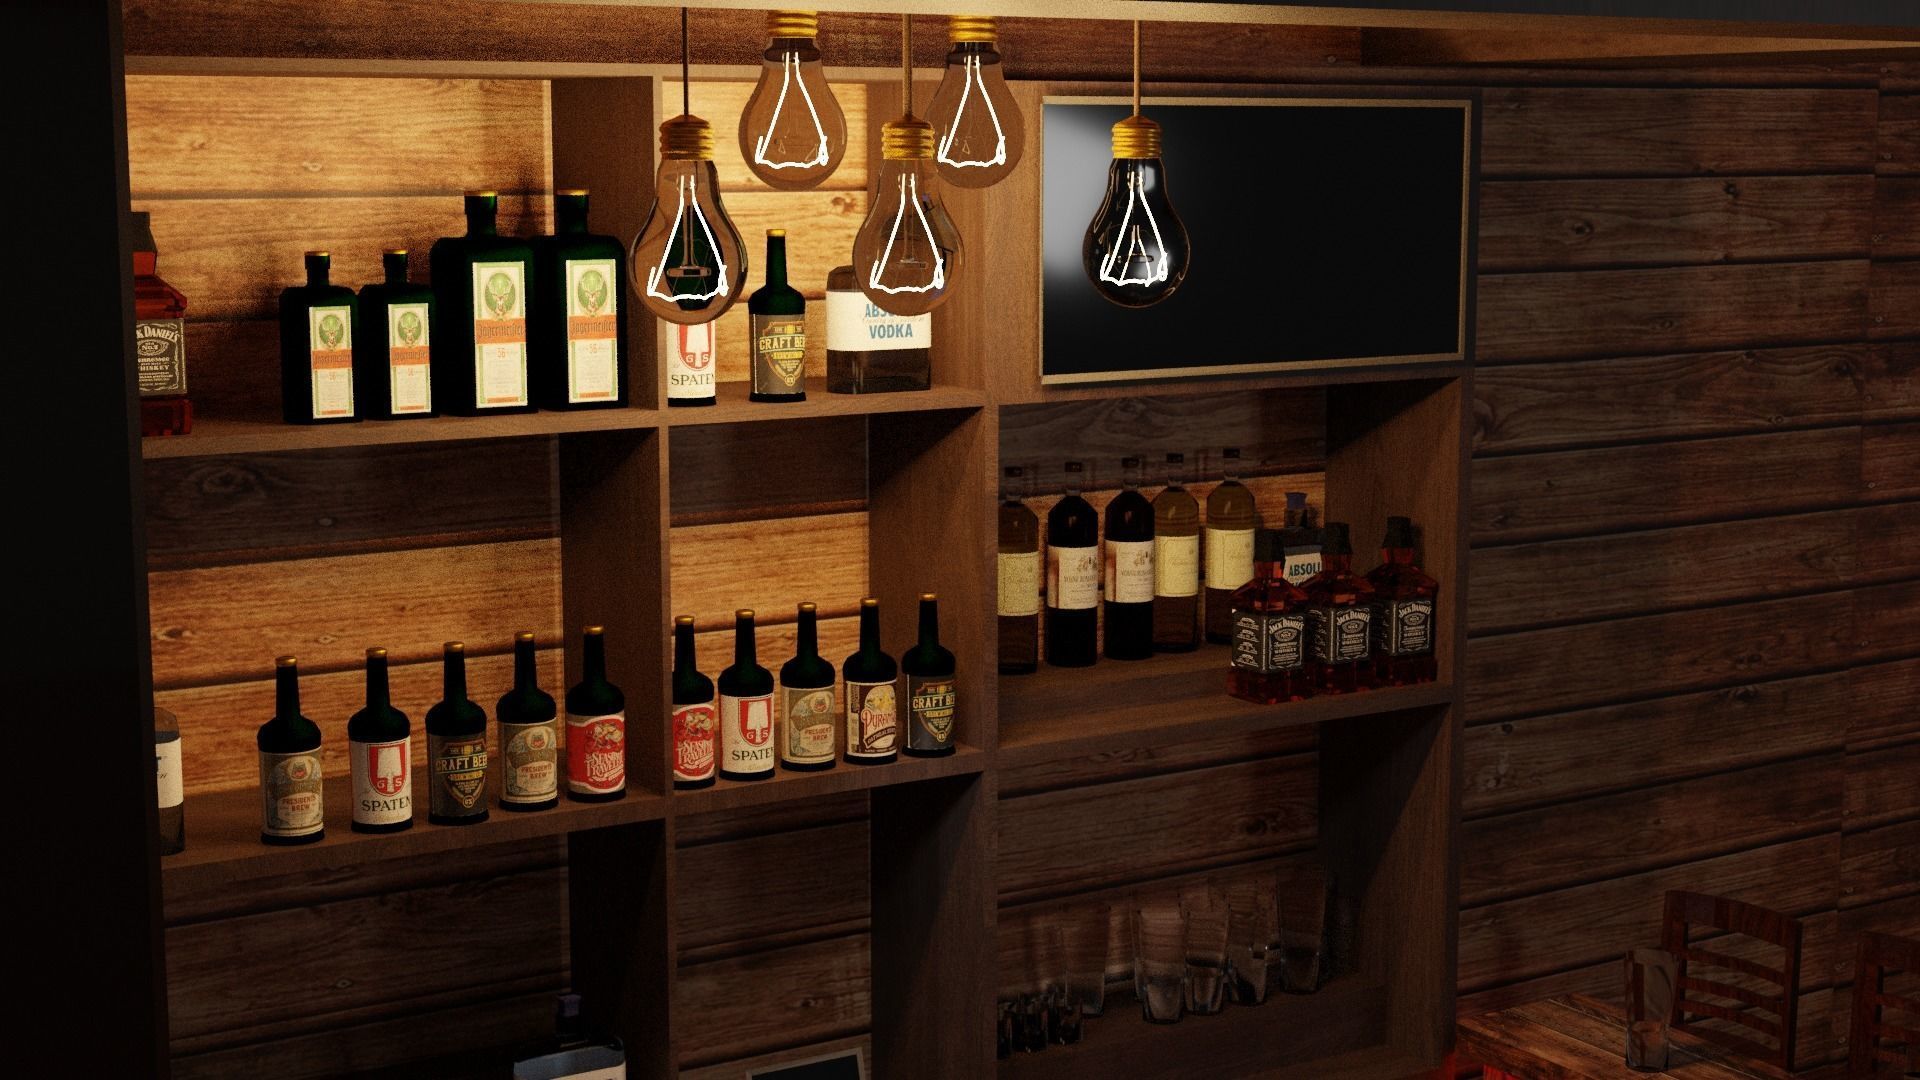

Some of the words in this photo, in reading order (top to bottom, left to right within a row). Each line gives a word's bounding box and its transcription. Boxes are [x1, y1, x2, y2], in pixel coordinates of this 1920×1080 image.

[869, 323, 914, 339] VODKA
[759, 336, 792, 351] CRAFT
[671, 373, 714, 386] SPATE
[912, 696, 944, 709] CRAFT
[731, 747, 774, 761] SPATE
[436, 757, 470, 771] CRAFT
